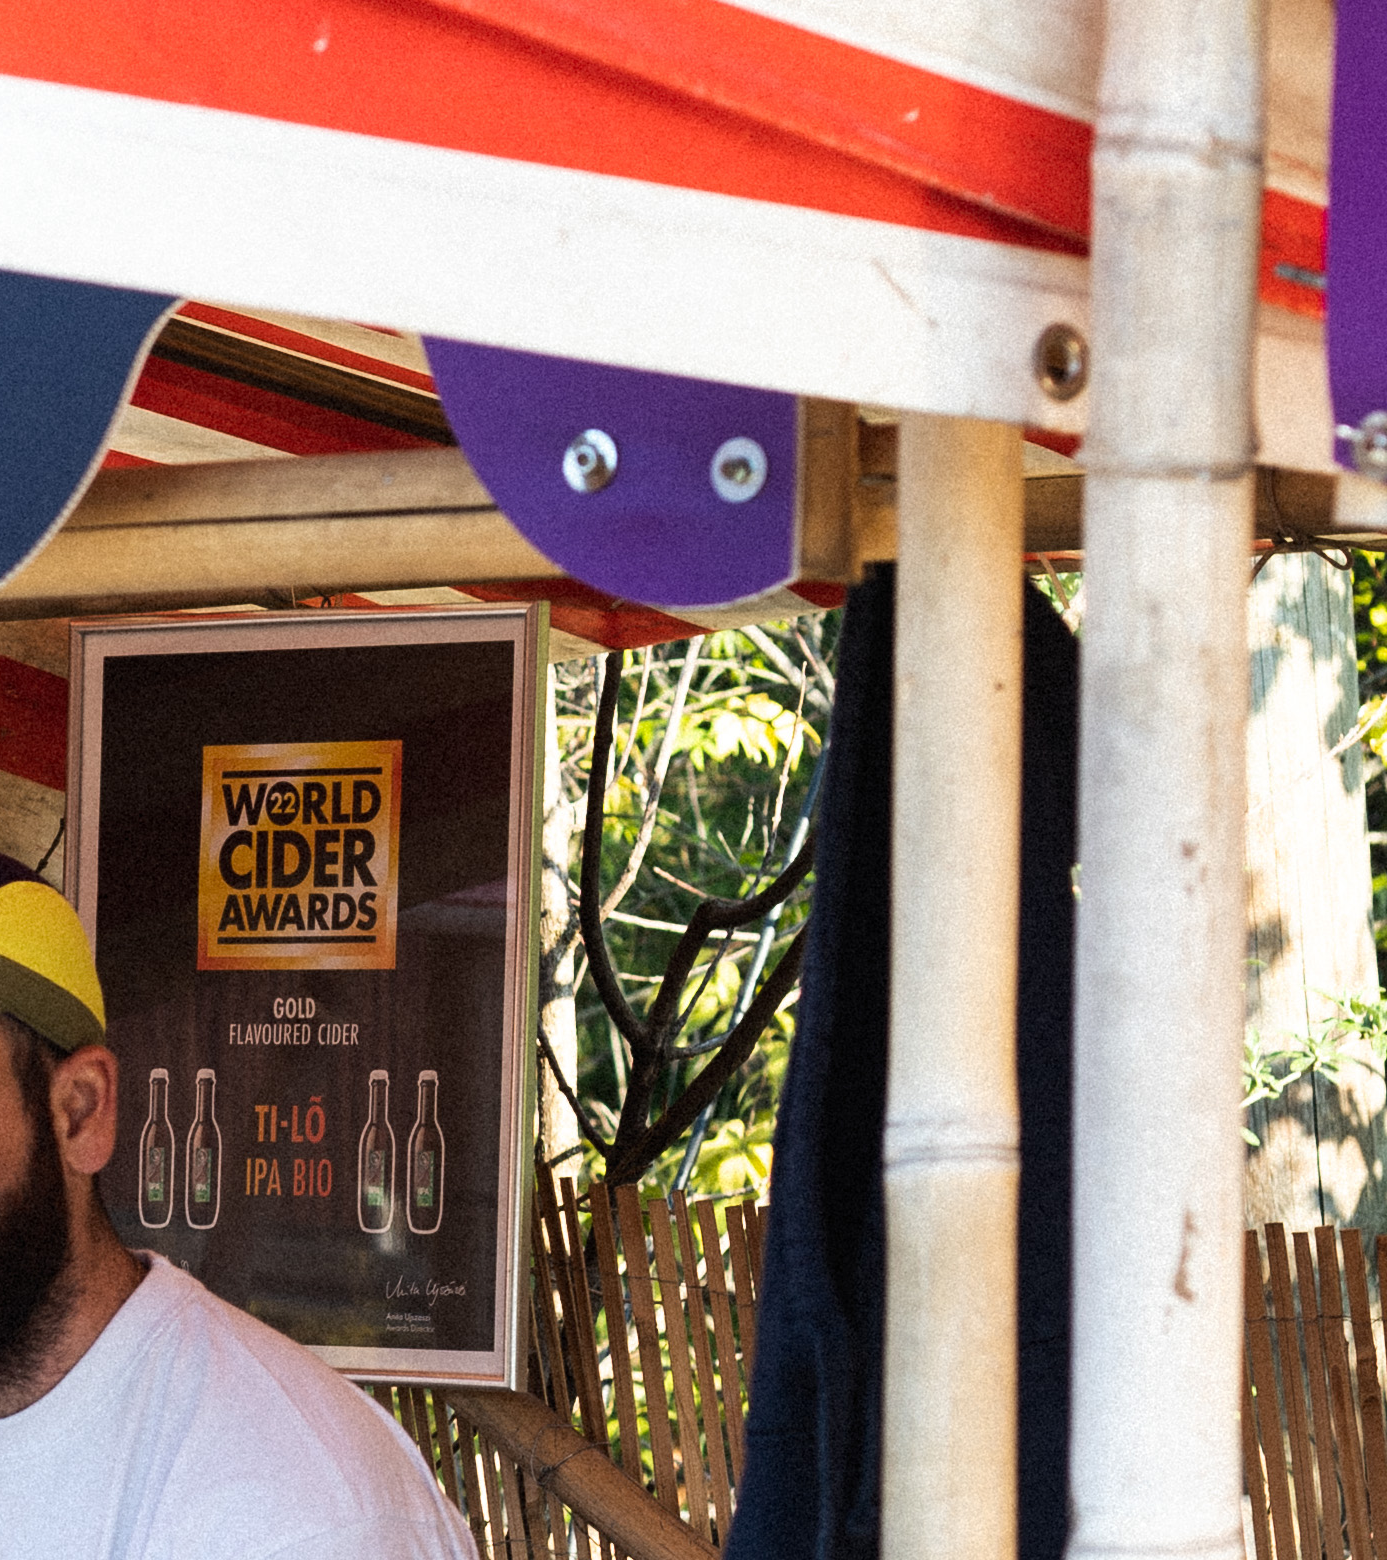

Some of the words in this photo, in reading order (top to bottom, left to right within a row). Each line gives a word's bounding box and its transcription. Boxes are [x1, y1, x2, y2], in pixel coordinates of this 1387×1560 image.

[219, 829, 378, 890] CIDER
[217, 891, 377, 931] AWARDS
[273, 997, 316, 1019] GOLD
[229, 1023, 311, 1045] FLAVOURED
[317, 1023, 359, 1045] CIDER
[255, 1096, 325, 1143] TI-LÕ
[246, 1158, 282, 1196] IPA
[293, 1158, 333, 1197] BIO
